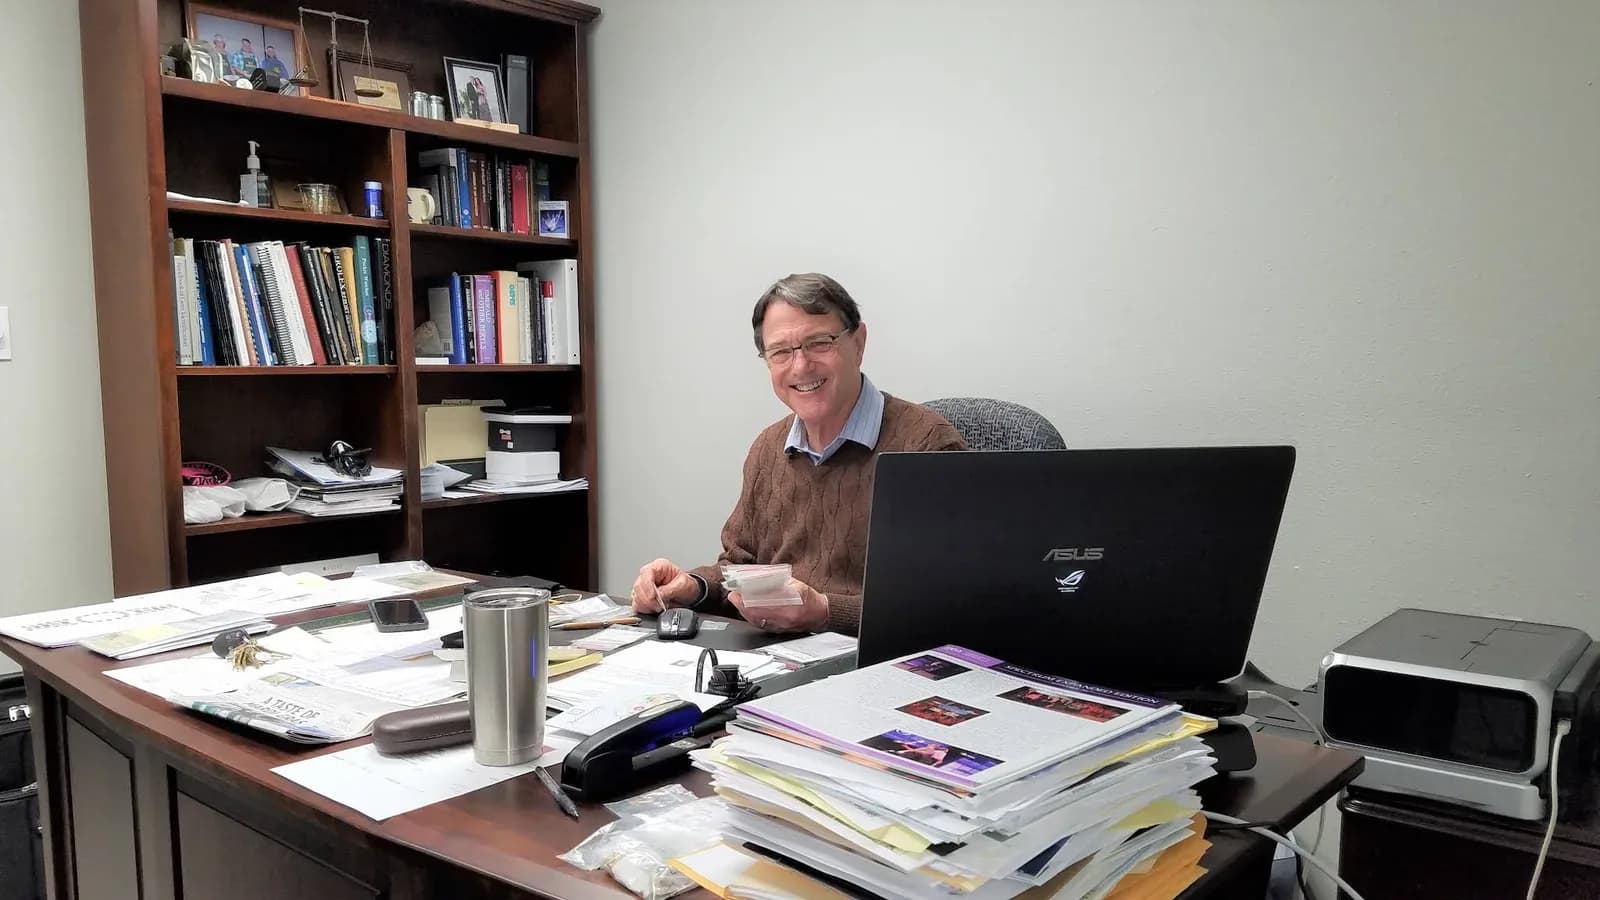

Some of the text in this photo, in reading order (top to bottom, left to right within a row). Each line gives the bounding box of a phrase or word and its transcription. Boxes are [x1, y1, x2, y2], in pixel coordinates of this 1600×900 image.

[335, 260, 346, 290] ROLEX
[382, 243, 392, 310] DIAMONDS
[1042, 548, 1104, 561] ASUS
[1006, 665, 1161, 704] SPECTRUM EXPANDED EDITION
[272, 699, 304, 714] TASTE
[300, 709, 321, 718] OF
